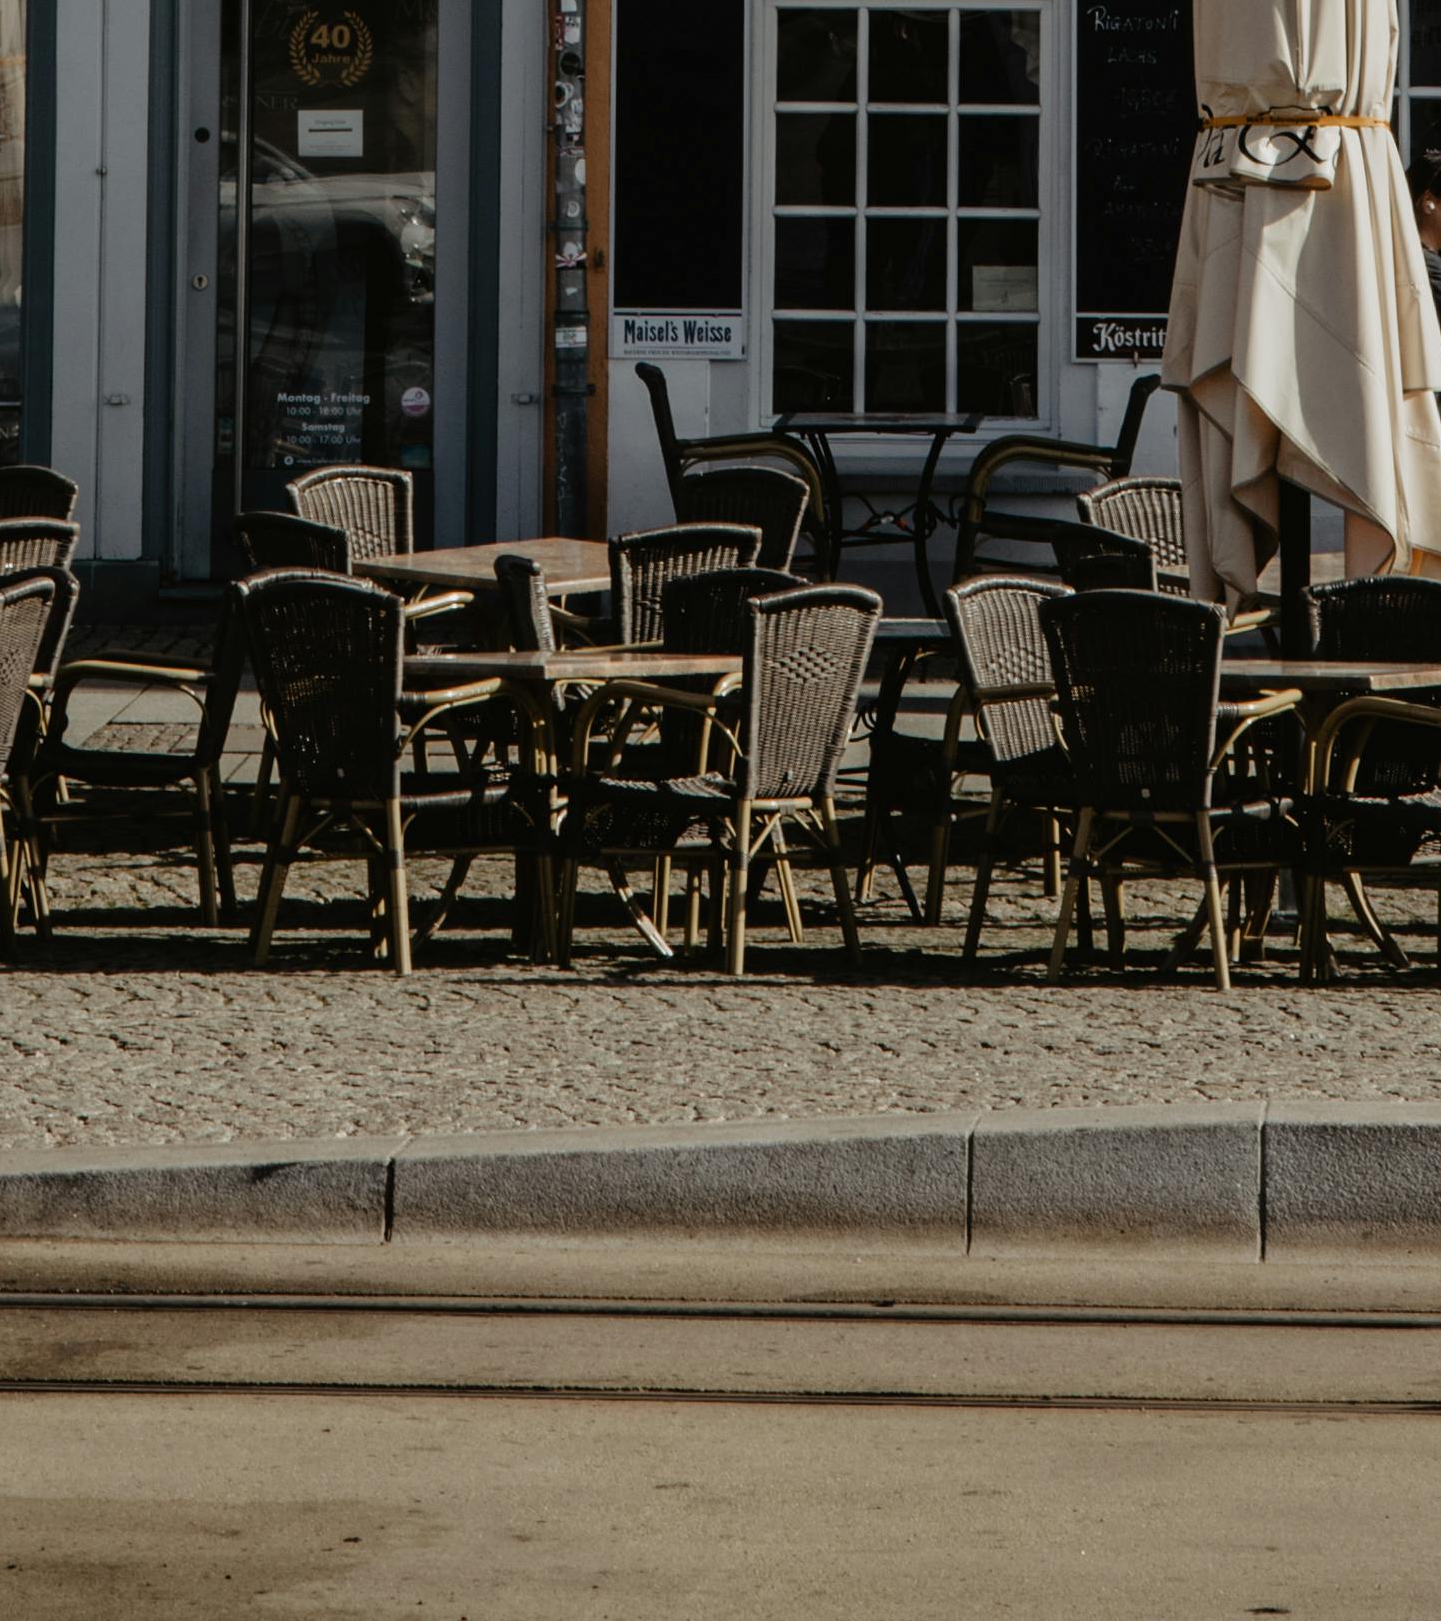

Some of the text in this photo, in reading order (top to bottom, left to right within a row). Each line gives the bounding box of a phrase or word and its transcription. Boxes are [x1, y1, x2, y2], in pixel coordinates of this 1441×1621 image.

[310, 24, 351, 49] 40
[311, 52, 352, 65] Jahre
[624, 319, 732, 344] Maisel's Weisse
[1092, 321, 1167, 352] Köstrit
[277, 393, 371, 406] Montag Freitag
[302, 423, 345, 434] Samstag
